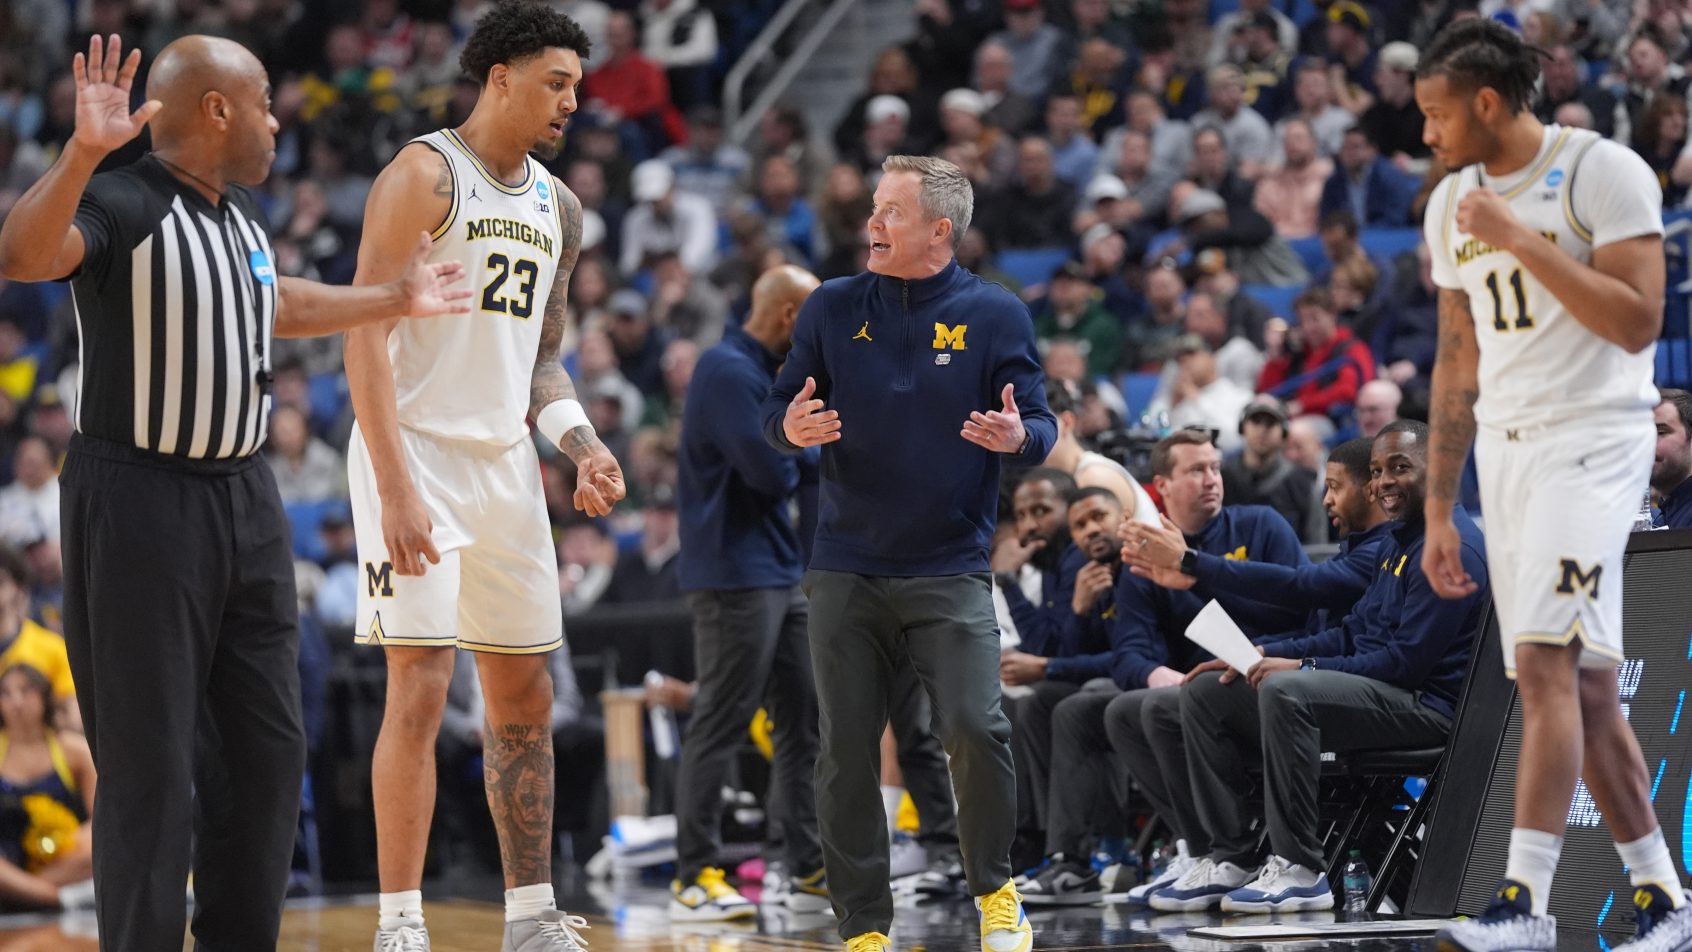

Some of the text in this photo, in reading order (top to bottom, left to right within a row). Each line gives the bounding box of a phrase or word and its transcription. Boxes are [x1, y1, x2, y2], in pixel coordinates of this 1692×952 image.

[466, 218, 553, 258] MICHIGAN
[482, 252, 538, 319] 23
[1486, 268, 1535, 331] 11
[932, 321, 968, 350] M
[365, 560, 394, 598] M
[1556, 558, 1603, 600] M
[504, 723, 533, 739] WHY
